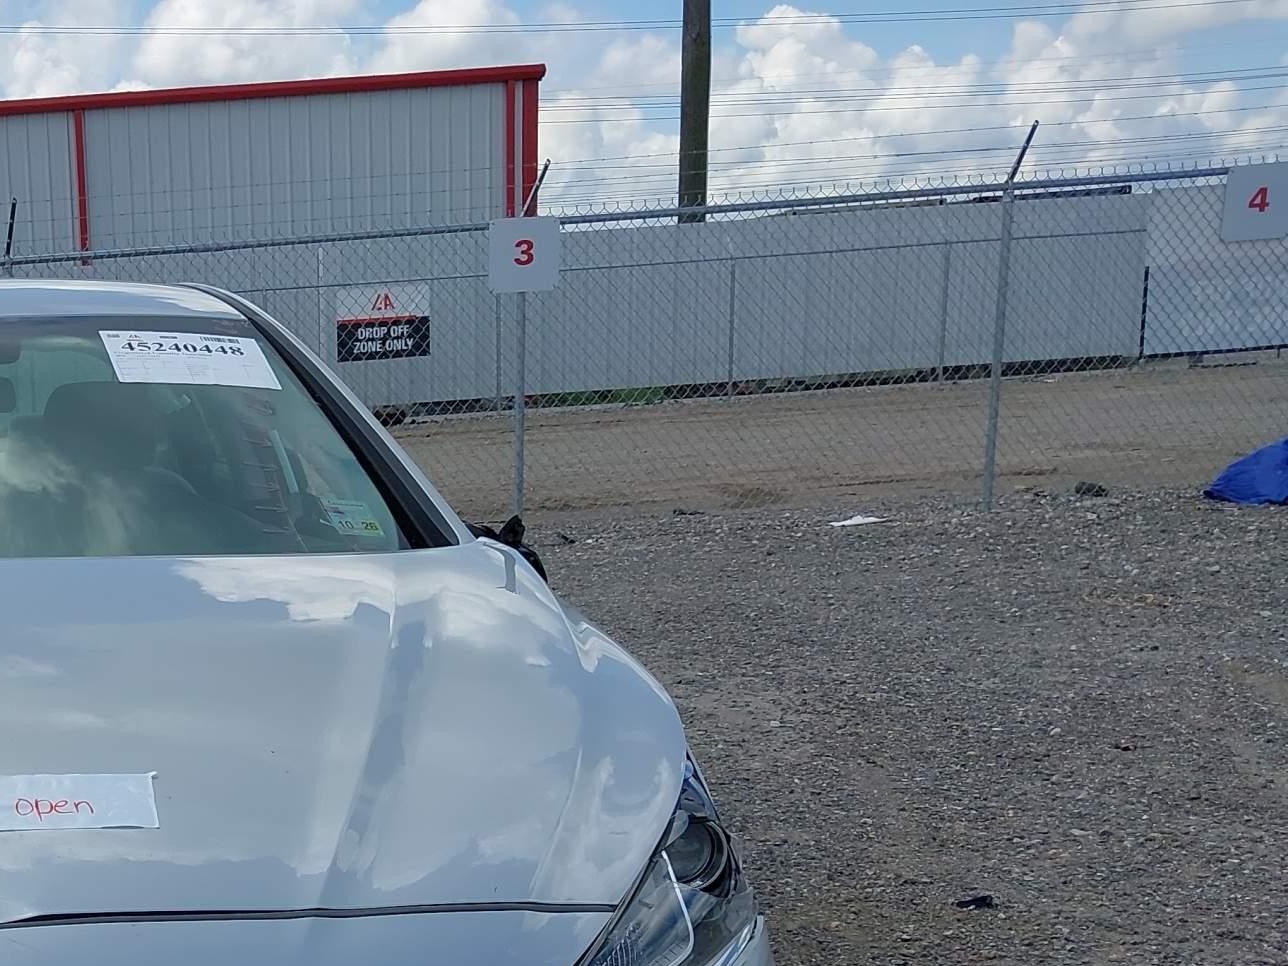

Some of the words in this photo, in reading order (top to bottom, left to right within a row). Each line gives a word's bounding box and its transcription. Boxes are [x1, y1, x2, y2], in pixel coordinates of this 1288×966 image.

[1247, 186, 1271, 213] 4
[513, 239, 535, 266] 3
[358, 326, 388, 339] DROP
[390, 324, 410, 337] OFF
[121, 341, 245, 356] 45240448
[353, 340, 383, 353] ZONE
[386, 338, 414, 351] ONLY
[15, 798, 95, 823] open
